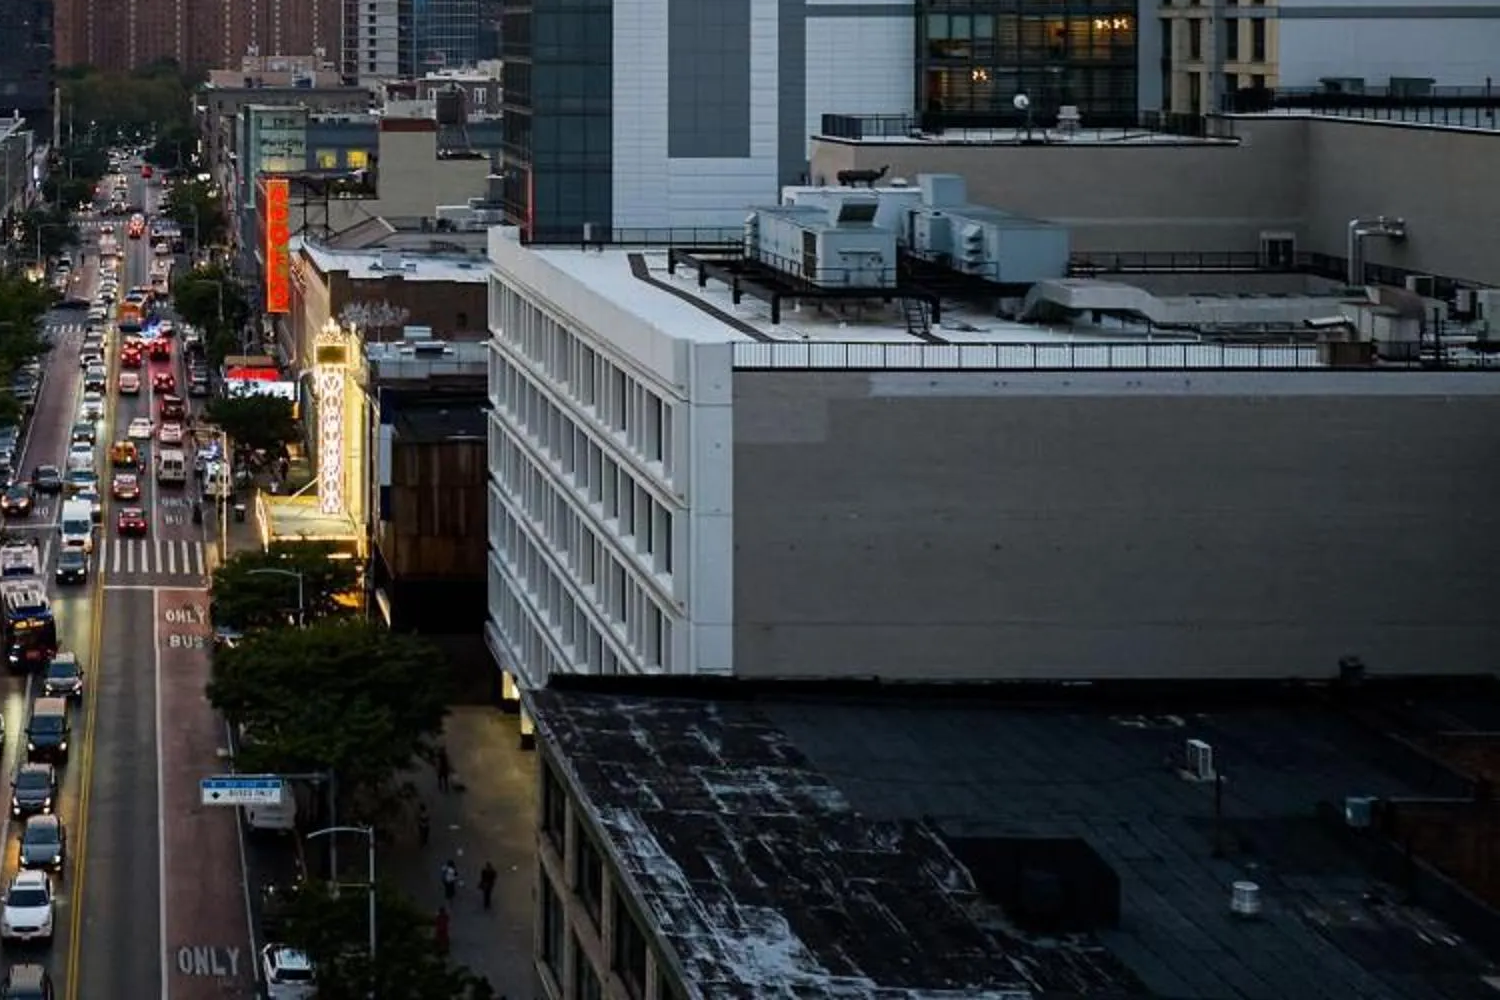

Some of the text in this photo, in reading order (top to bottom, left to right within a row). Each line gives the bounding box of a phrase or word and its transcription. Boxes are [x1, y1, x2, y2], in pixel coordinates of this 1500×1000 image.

[165, 606, 205, 624] ONLY
[169, 634, 204, 649] BUS
[178, 945, 240, 976] ONLY
